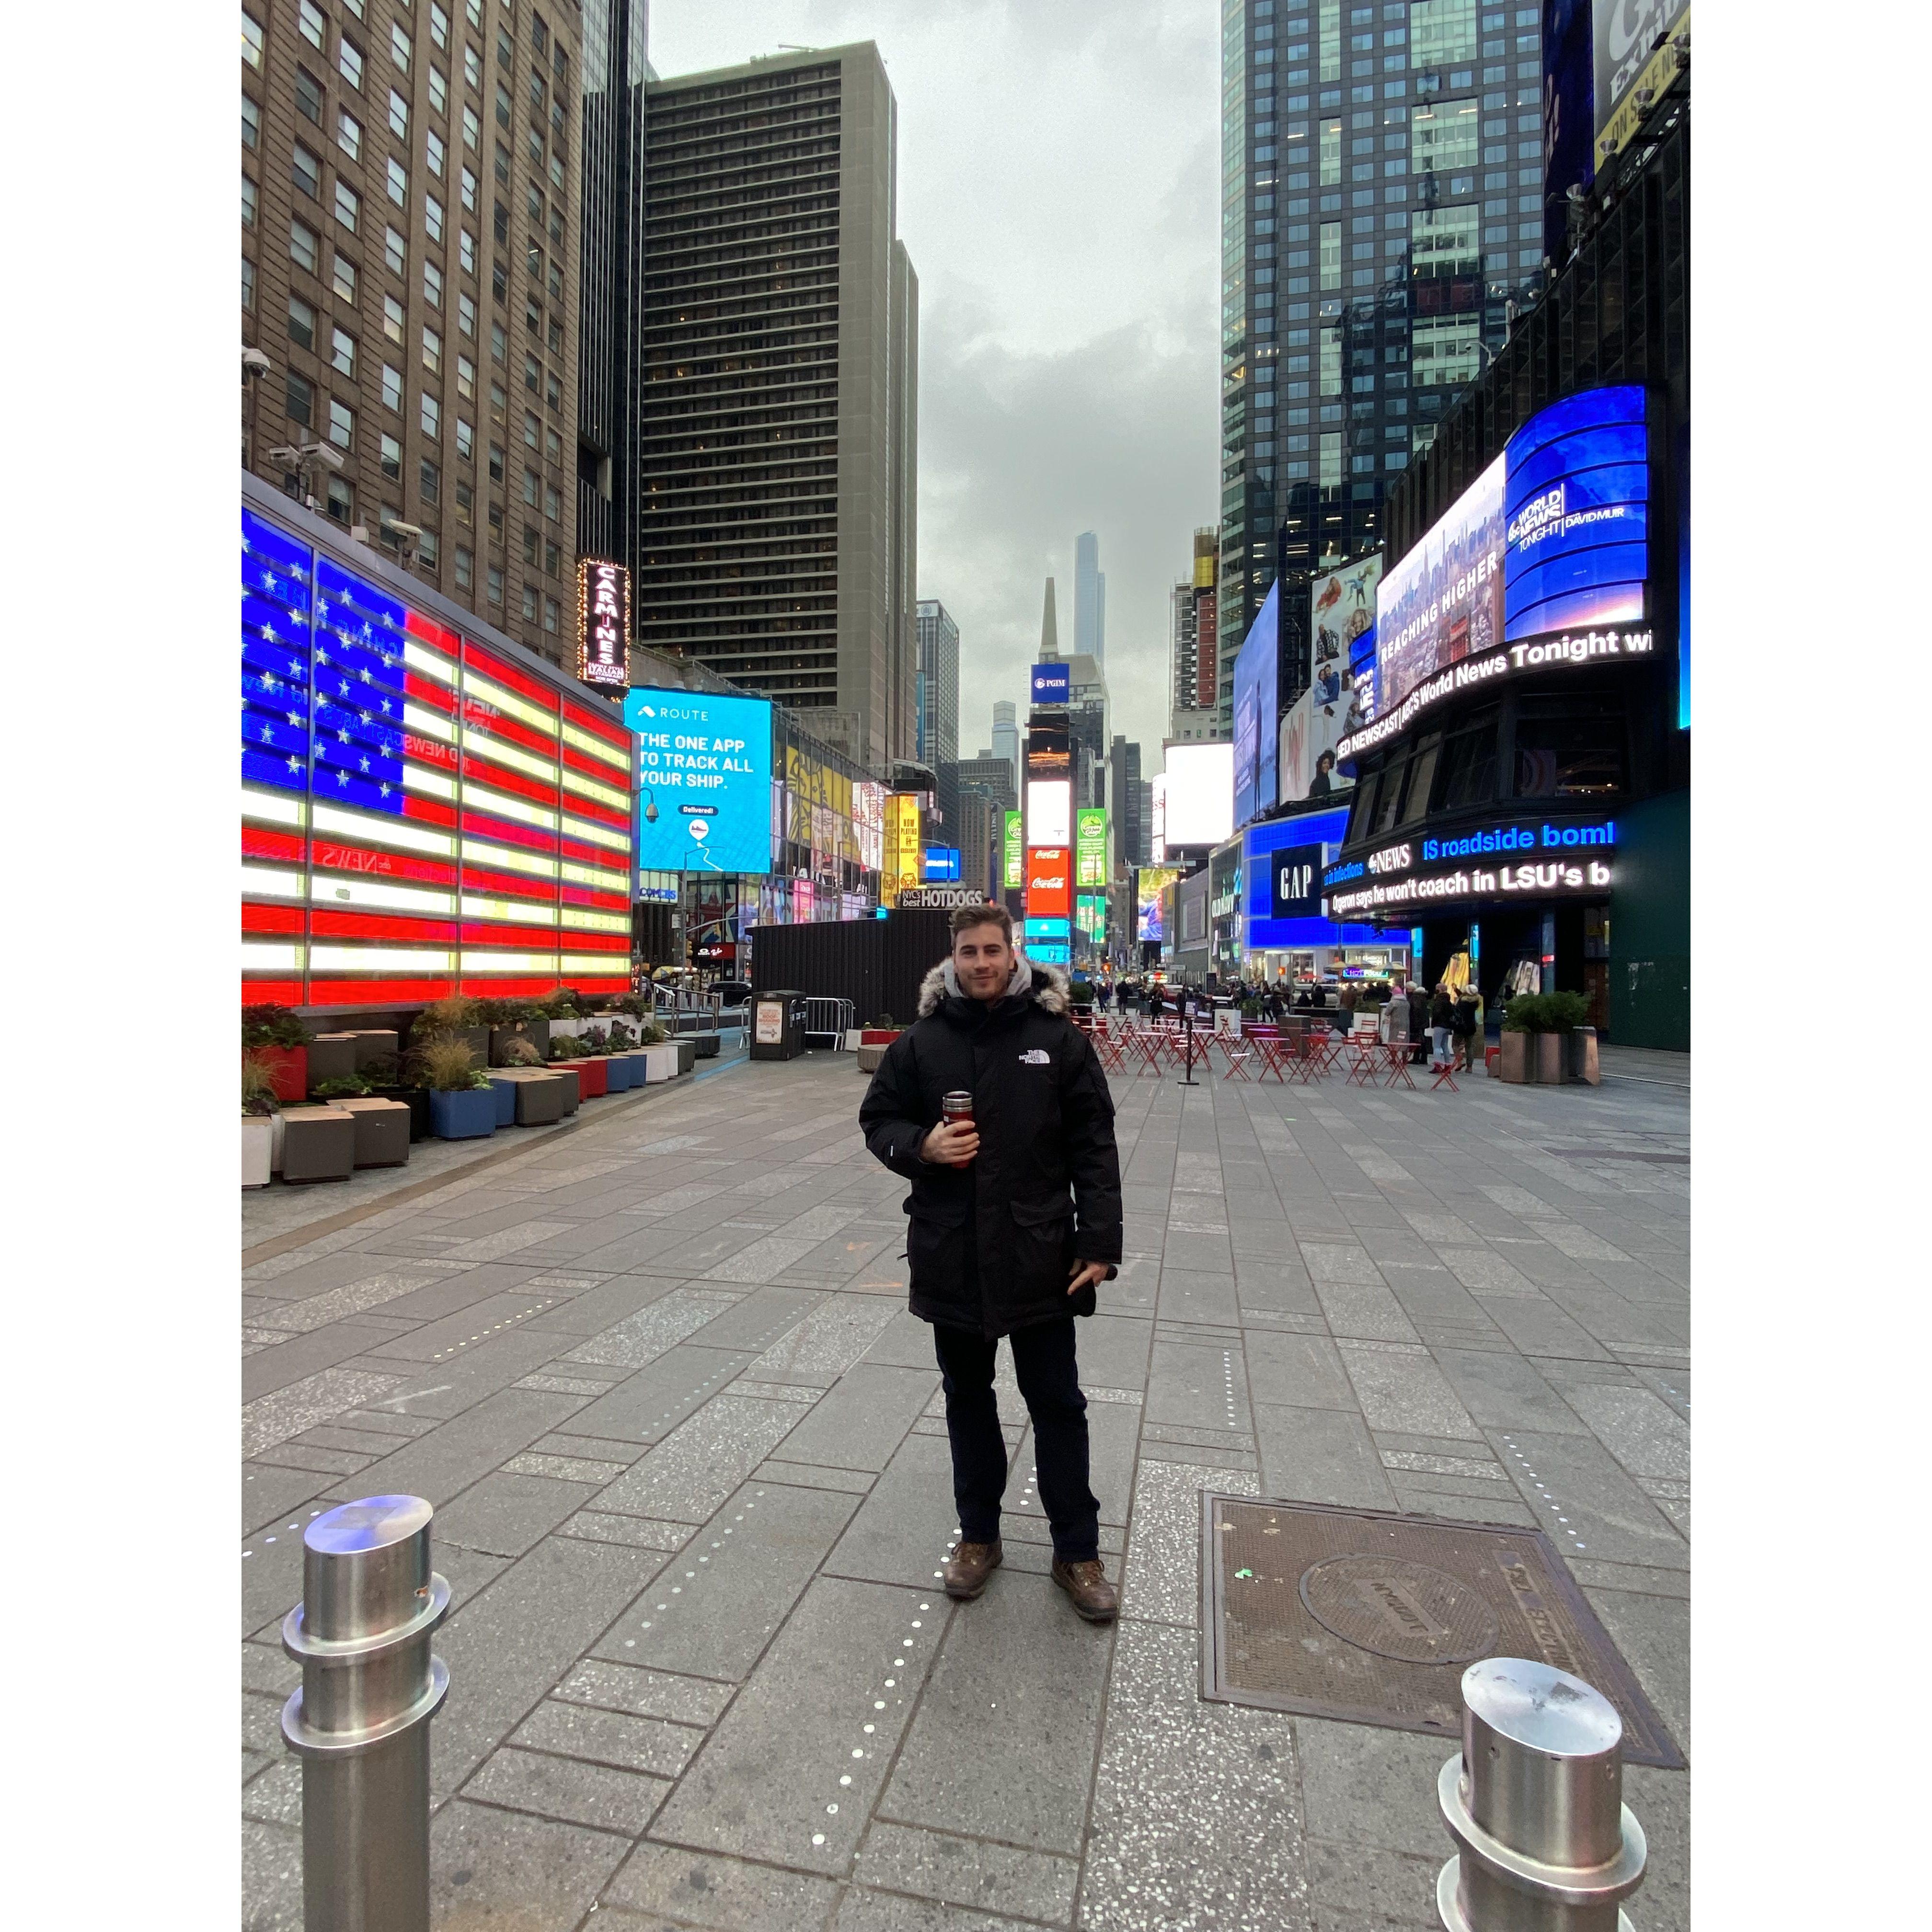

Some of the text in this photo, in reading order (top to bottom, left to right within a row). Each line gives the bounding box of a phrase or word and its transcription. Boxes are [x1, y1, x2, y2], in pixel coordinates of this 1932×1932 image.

[1612, 107, 1627, 140] ON
[1518, 490, 1561, 526] WORLD
[1520, 504, 1562, 538] NEWS
[1565, 507, 1625, 528] DAVID MUIR
[1519, 519, 1561, 552] TONIGHT
[1381, 551, 1498, 665] REACHING HIGHER
[1351, 710, 1399, 752] NEWSCAST
[1419, 674, 1453, 705] World
[1456, 656, 1507, 689] News
[1509, 632, 1619, 667] Tonight
[660, 708, 709, 721] ROUTE
[640, 732, 745, 753] THE ONE APP
[640, 751, 754, 773] TO TRACK ALL
[640, 770, 728, 790] YOUR SHIP.
[1376, 843, 1410, 874] NEWS
[1424, 840, 1438, 861] IS
[1441, 827, 1534, 857] roadside
[1280, 865, 1311, 900] GAP
[1333, 862, 1610, 914] Orgeron says he won't coach in LSU's b
[903, 898, 920, 907] best
